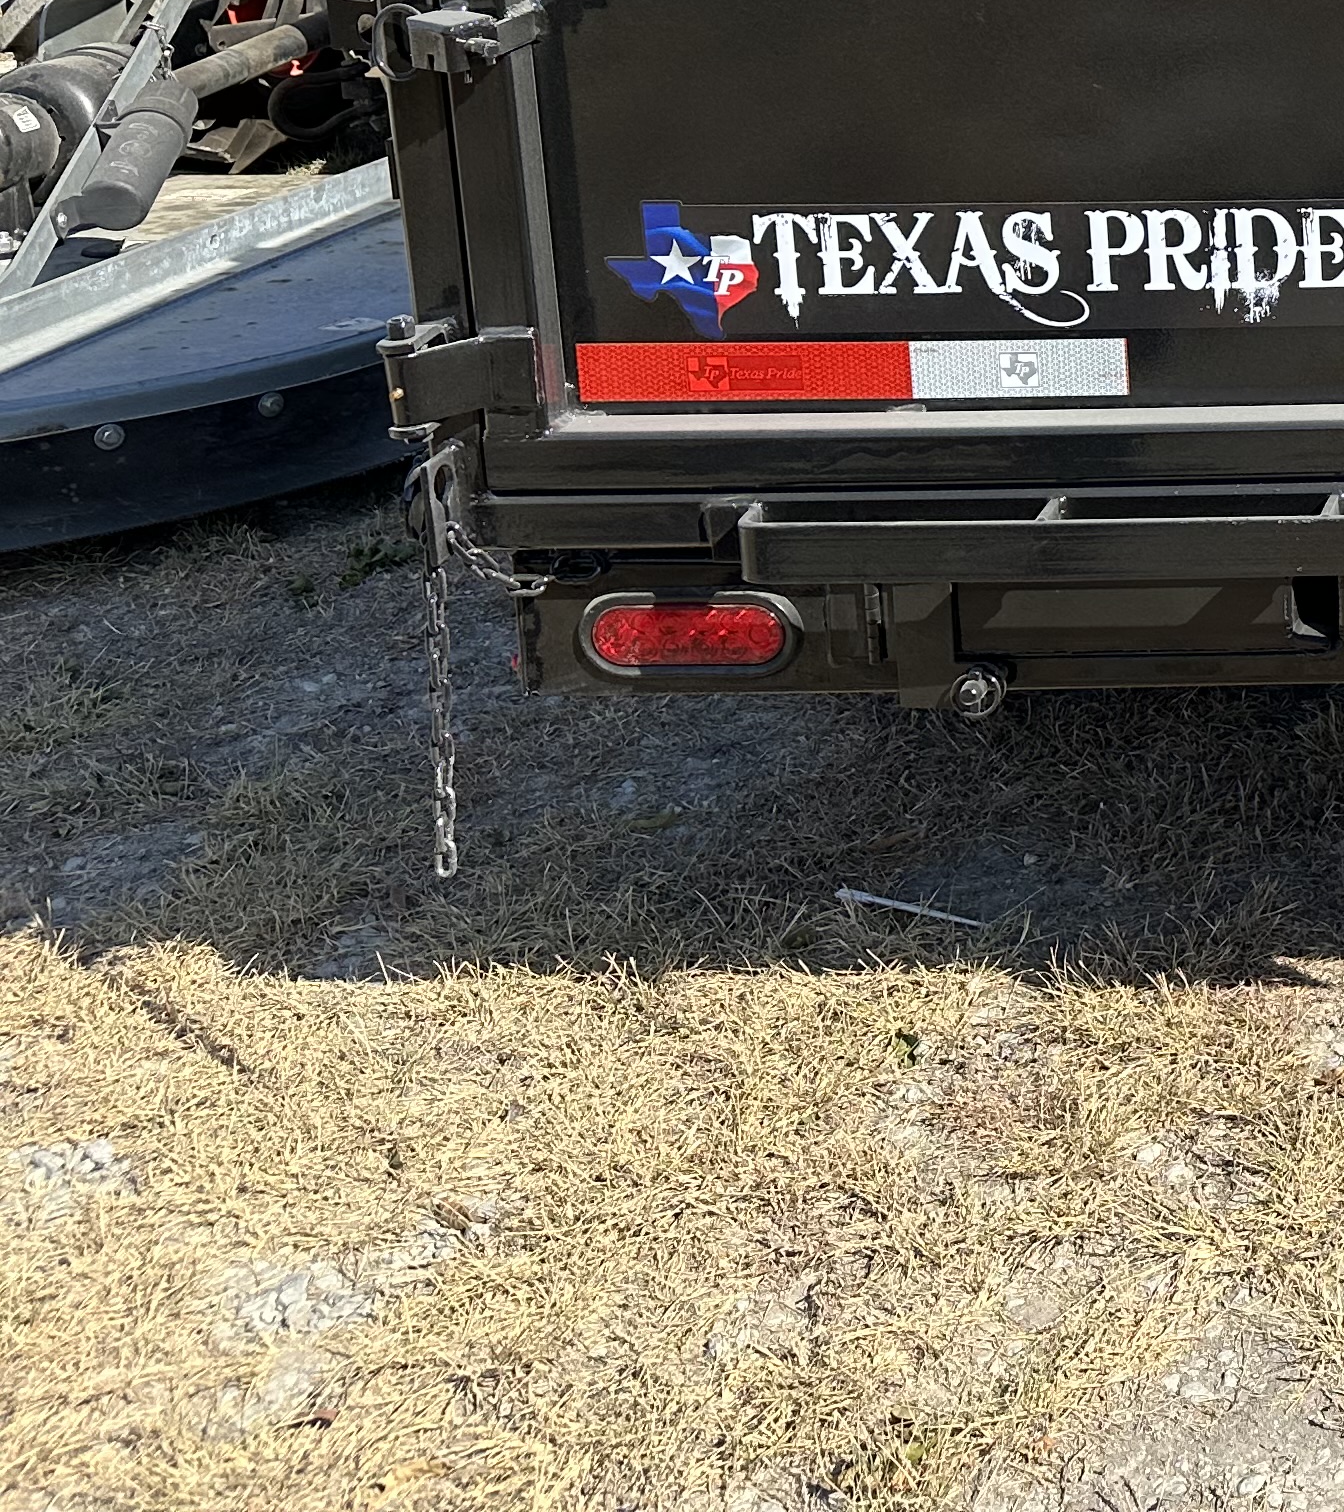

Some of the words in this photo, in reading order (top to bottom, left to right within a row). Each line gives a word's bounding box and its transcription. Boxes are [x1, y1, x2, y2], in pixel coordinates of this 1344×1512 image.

[702, 255, 744, 295] TP
[752, 209, 1089, 327] TEXAS
[730, 367, 764, 379] Texas
[766, 367, 802, 379] Pride
